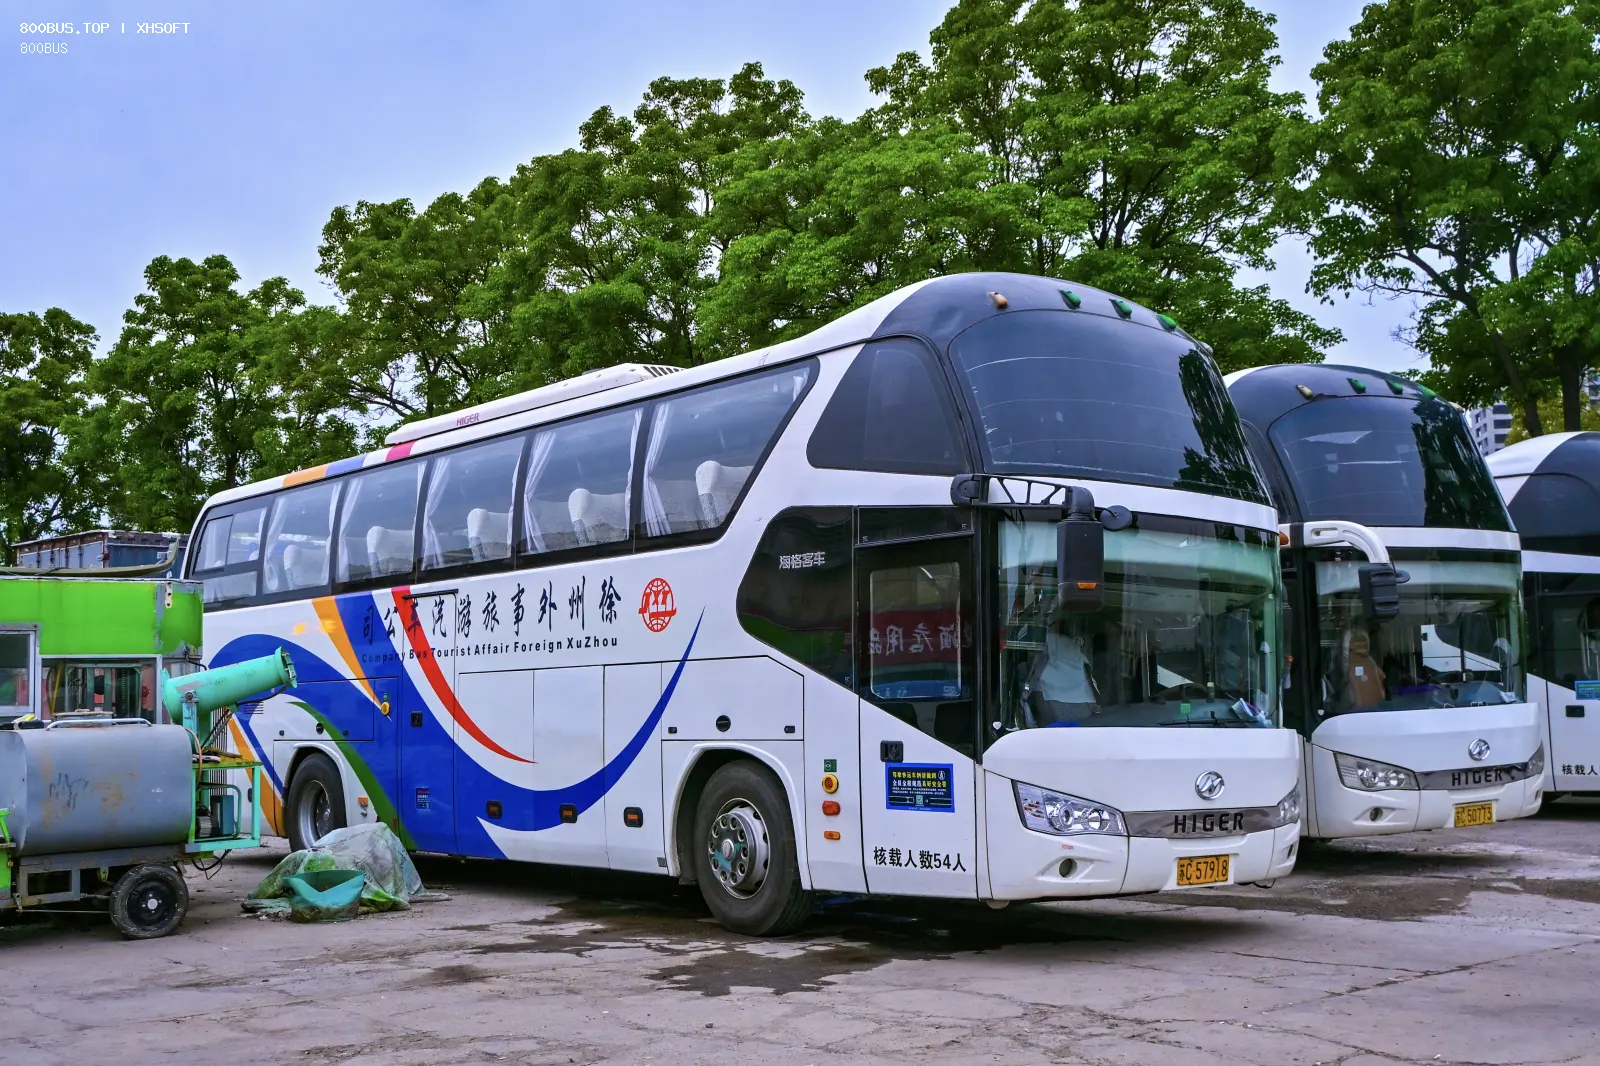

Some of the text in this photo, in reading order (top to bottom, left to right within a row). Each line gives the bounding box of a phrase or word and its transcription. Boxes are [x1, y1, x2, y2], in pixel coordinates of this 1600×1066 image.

[456, 413, 480, 426] HIGER
[778, 550, 826, 571] 海格客车
[362, 636, 618, 664] Company Bus Tourist Affair Foreign XuZhou
[1451, 768, 1503, 786] HIGER
[1561, 763, 1600, 776] 核载人
[1174, 812, 1244, 834] HIGER
[873, 845, 967, 873] 核载人数54人
